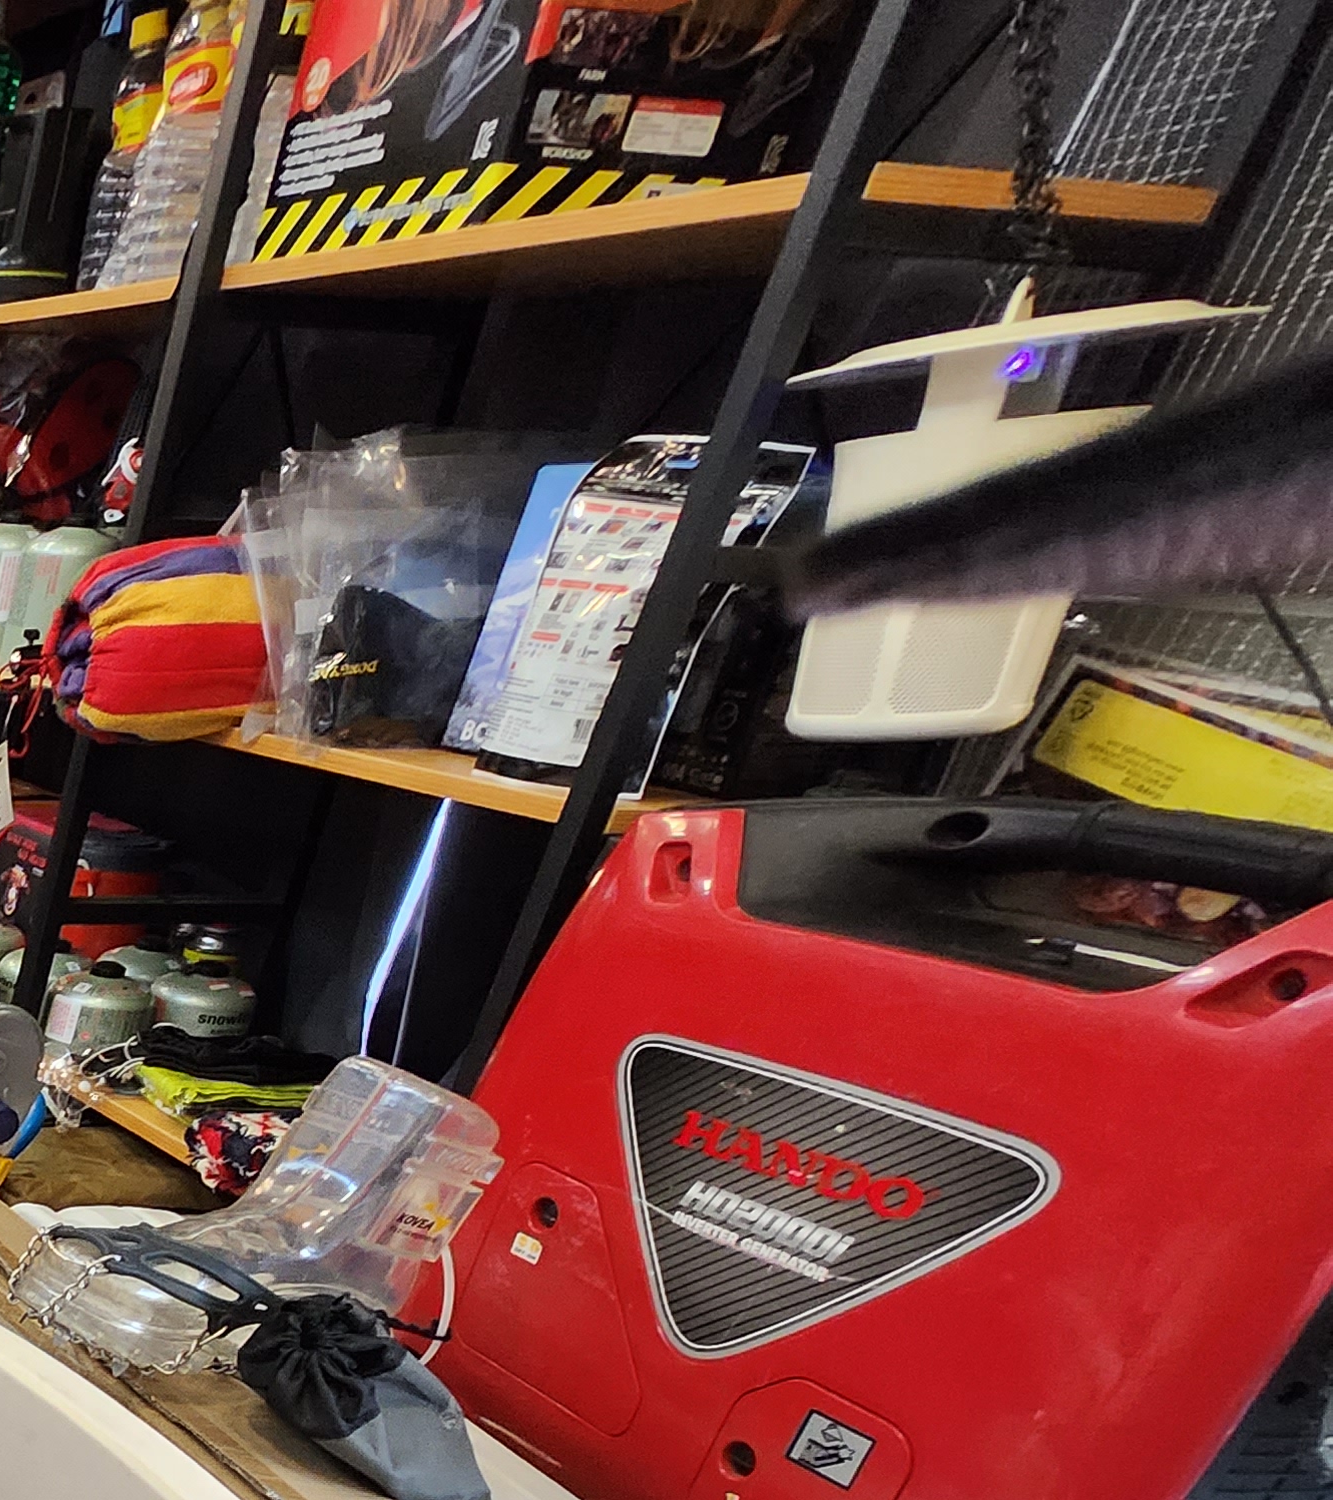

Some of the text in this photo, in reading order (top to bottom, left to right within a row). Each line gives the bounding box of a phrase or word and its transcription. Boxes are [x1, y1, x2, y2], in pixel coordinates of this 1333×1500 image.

[673, 1110, 926, 1219] HANDO
[396, 1212, 436, 1231] KOVEA
[672, 1210, 832, 1282] INVERTER GENERATOR
